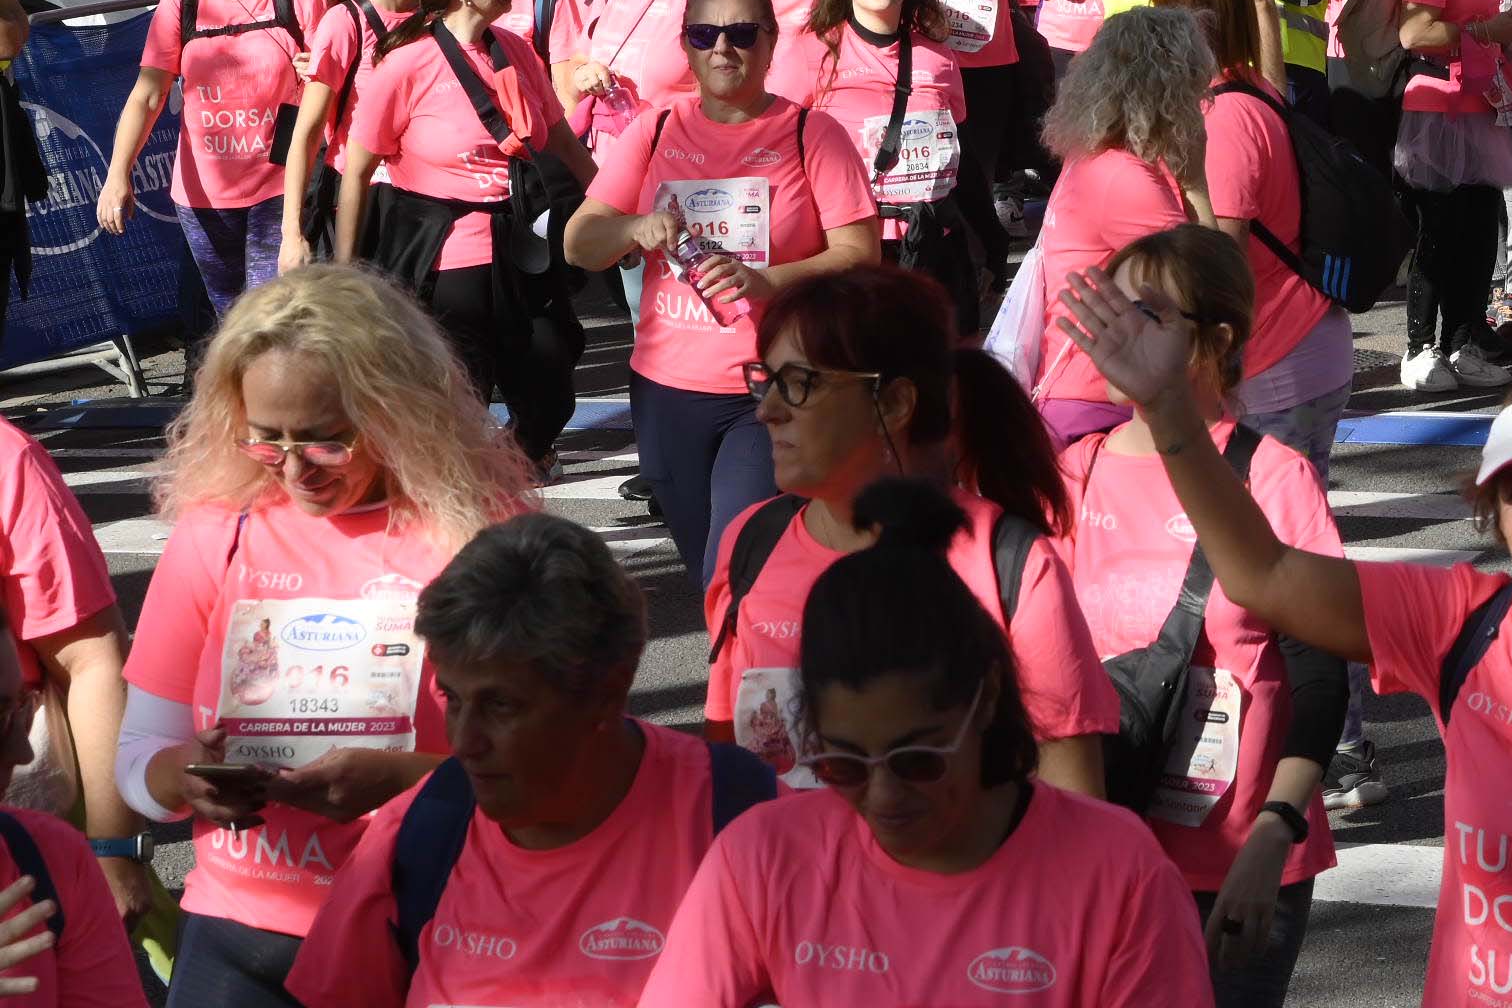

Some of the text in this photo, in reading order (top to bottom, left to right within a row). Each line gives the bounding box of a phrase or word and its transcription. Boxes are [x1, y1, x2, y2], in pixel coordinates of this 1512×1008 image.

[197, 86, 222, 104] TU
[202, 107, 275, 128] DORSA
[203, 135, 266, 154] SUMA
[901, 146, 931, 160] 016
[906, 162, 929, 172] 20834
[655, 291, 718, 324] SUM
[286, 625, 360, 643] ASTURIANA
[289, 697, 339, 714] 18343
[239, 721, 396, 733] CARRERA DE LA MUJER 2023
[238, 743, 295, 760] OYSHO
[1192, 781, 1216, 792] 2023
[1455, 820, 1508, 872] TU
[434, 924, 517, 960] OYSHO
[587, 934, 658, 952] ASTURIANA
[794, 941, 890, 973] OYSHO
[975, 962, 1048, 984] ASTURIANA
